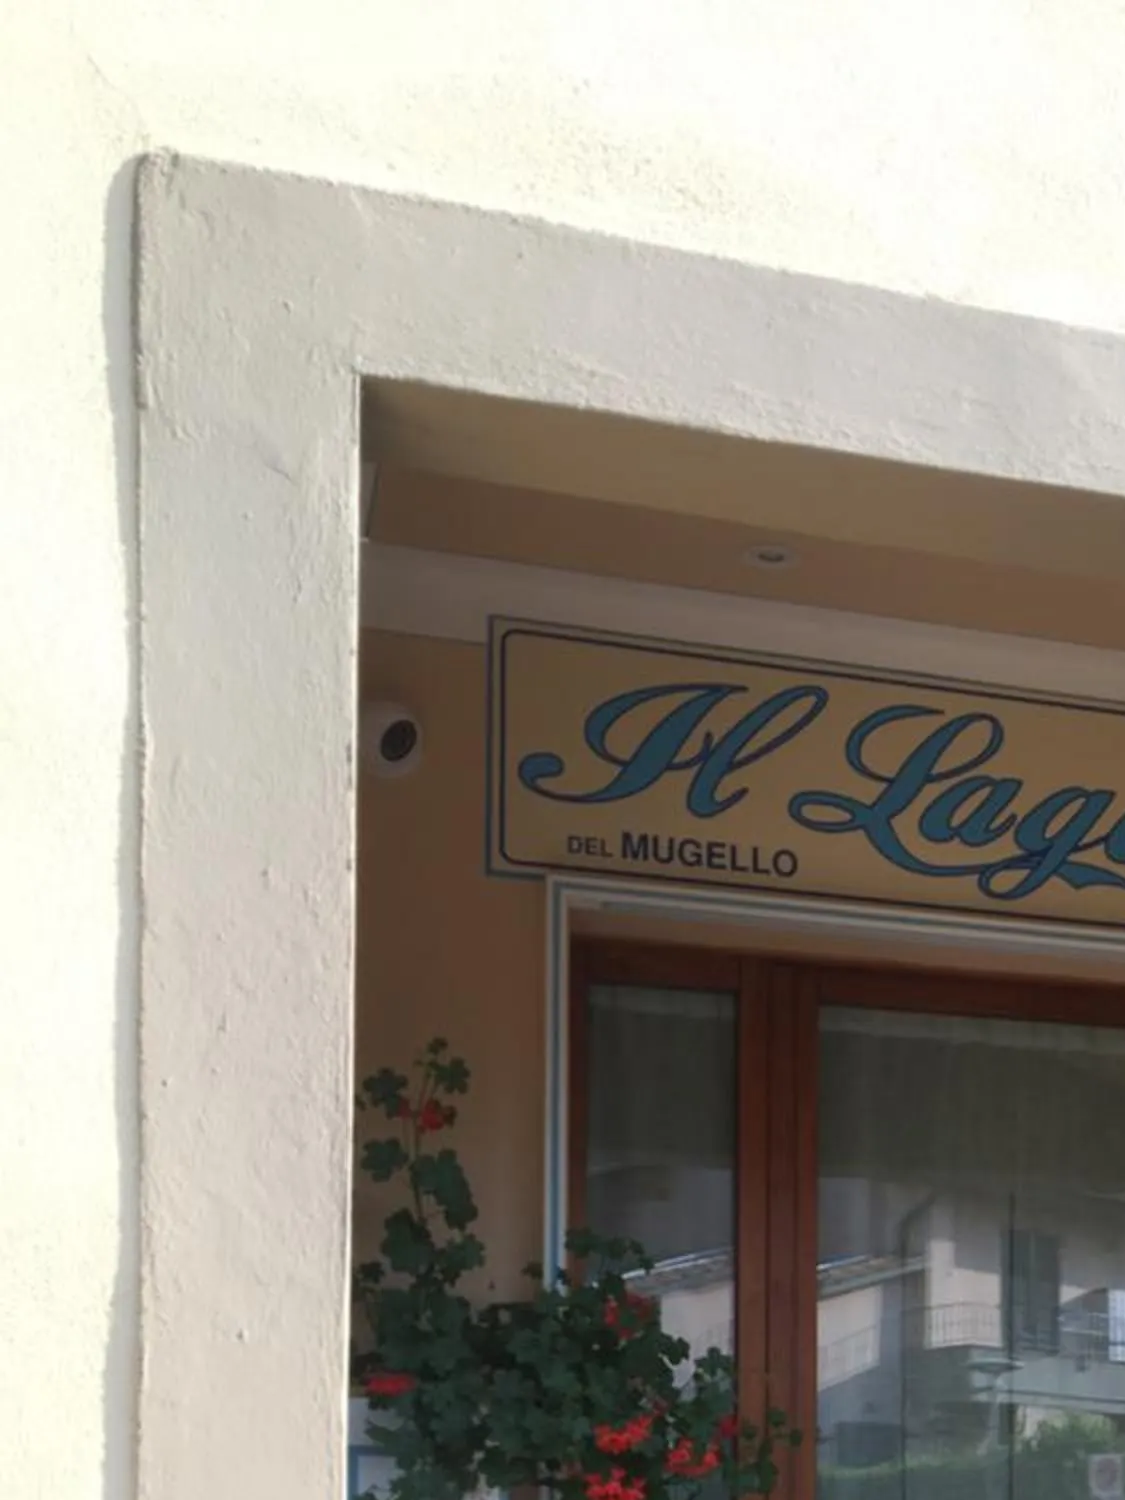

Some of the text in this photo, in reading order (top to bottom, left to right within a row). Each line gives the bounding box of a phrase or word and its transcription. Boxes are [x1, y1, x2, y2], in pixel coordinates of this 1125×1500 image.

[518, 682, 829, 819] Il
[566, 831, 799, 879] DEL MUGELLO
